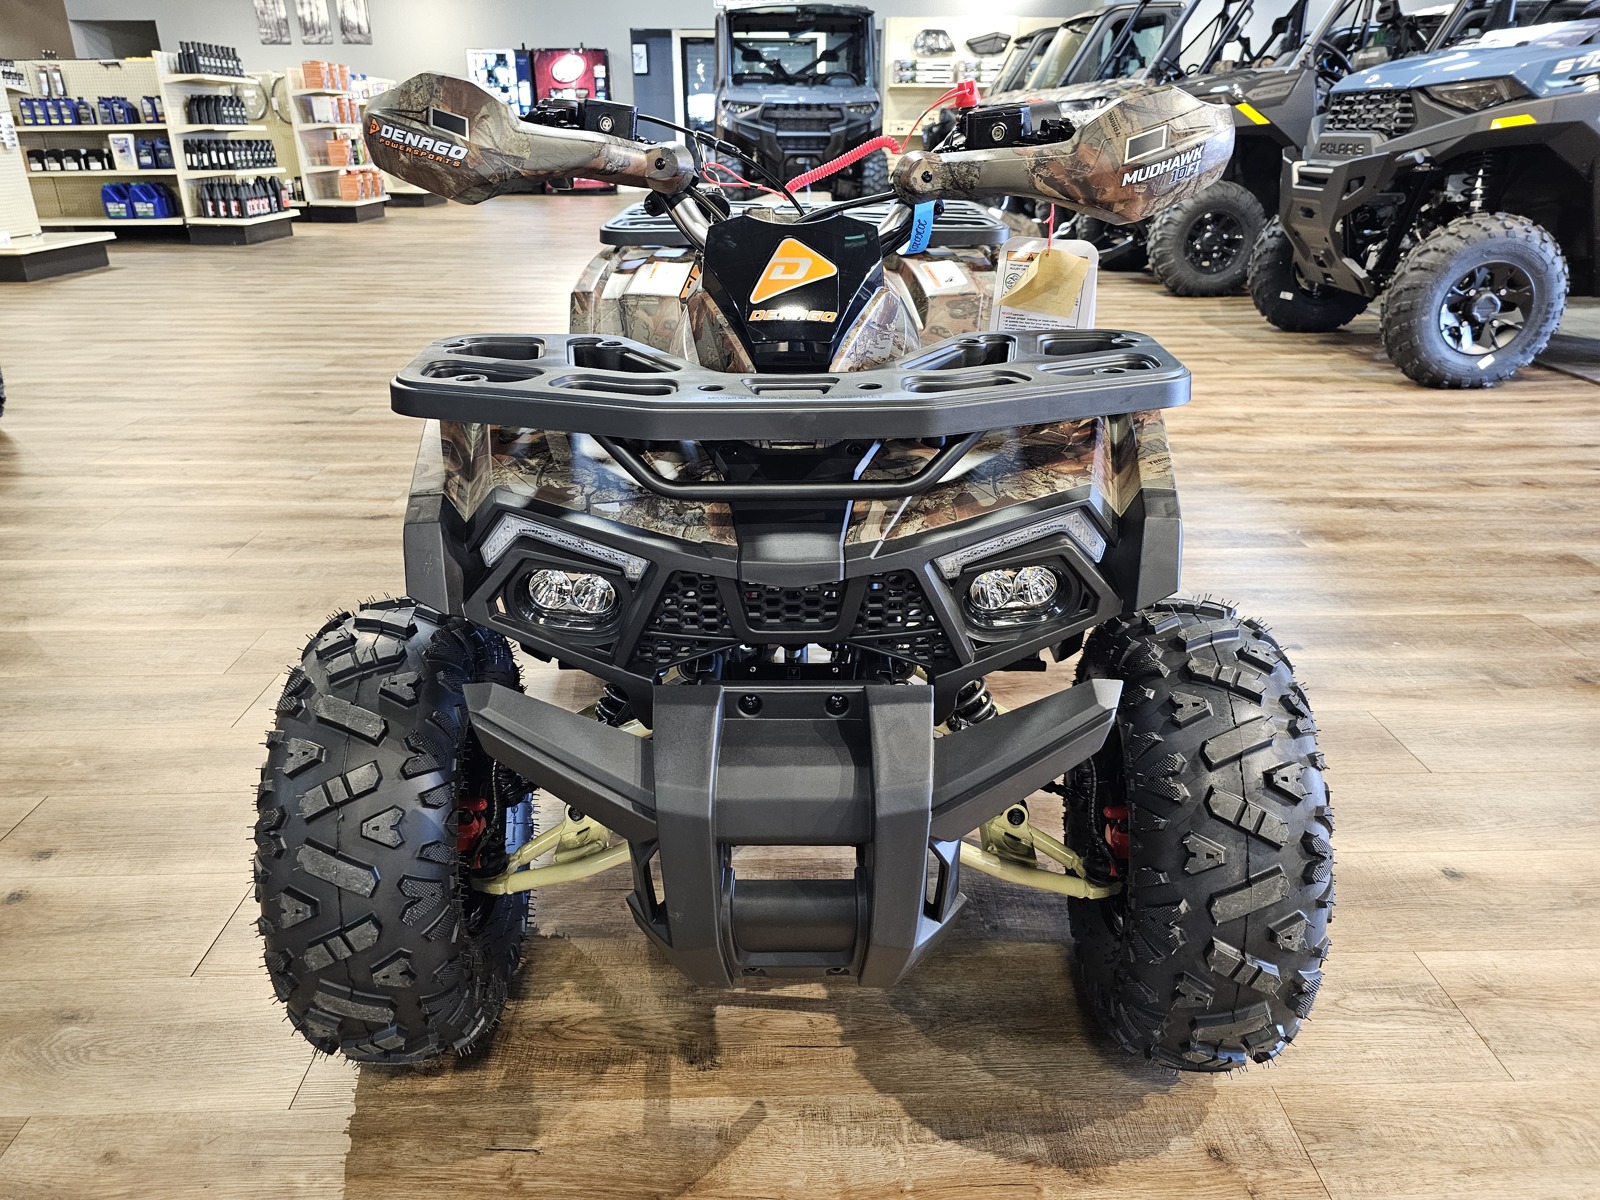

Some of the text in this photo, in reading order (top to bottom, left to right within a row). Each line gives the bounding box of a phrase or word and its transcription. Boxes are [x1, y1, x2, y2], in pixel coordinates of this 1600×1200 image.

[379, 138, 461, 167] POWERSPORTS
[380, 124, 469, 160] DENAGO
[1319, 142, 1365, 156] POLARIS
[1121, 145, 1204, 187] MUDHAWK
[749, 309, 838, 322] DENAGO
